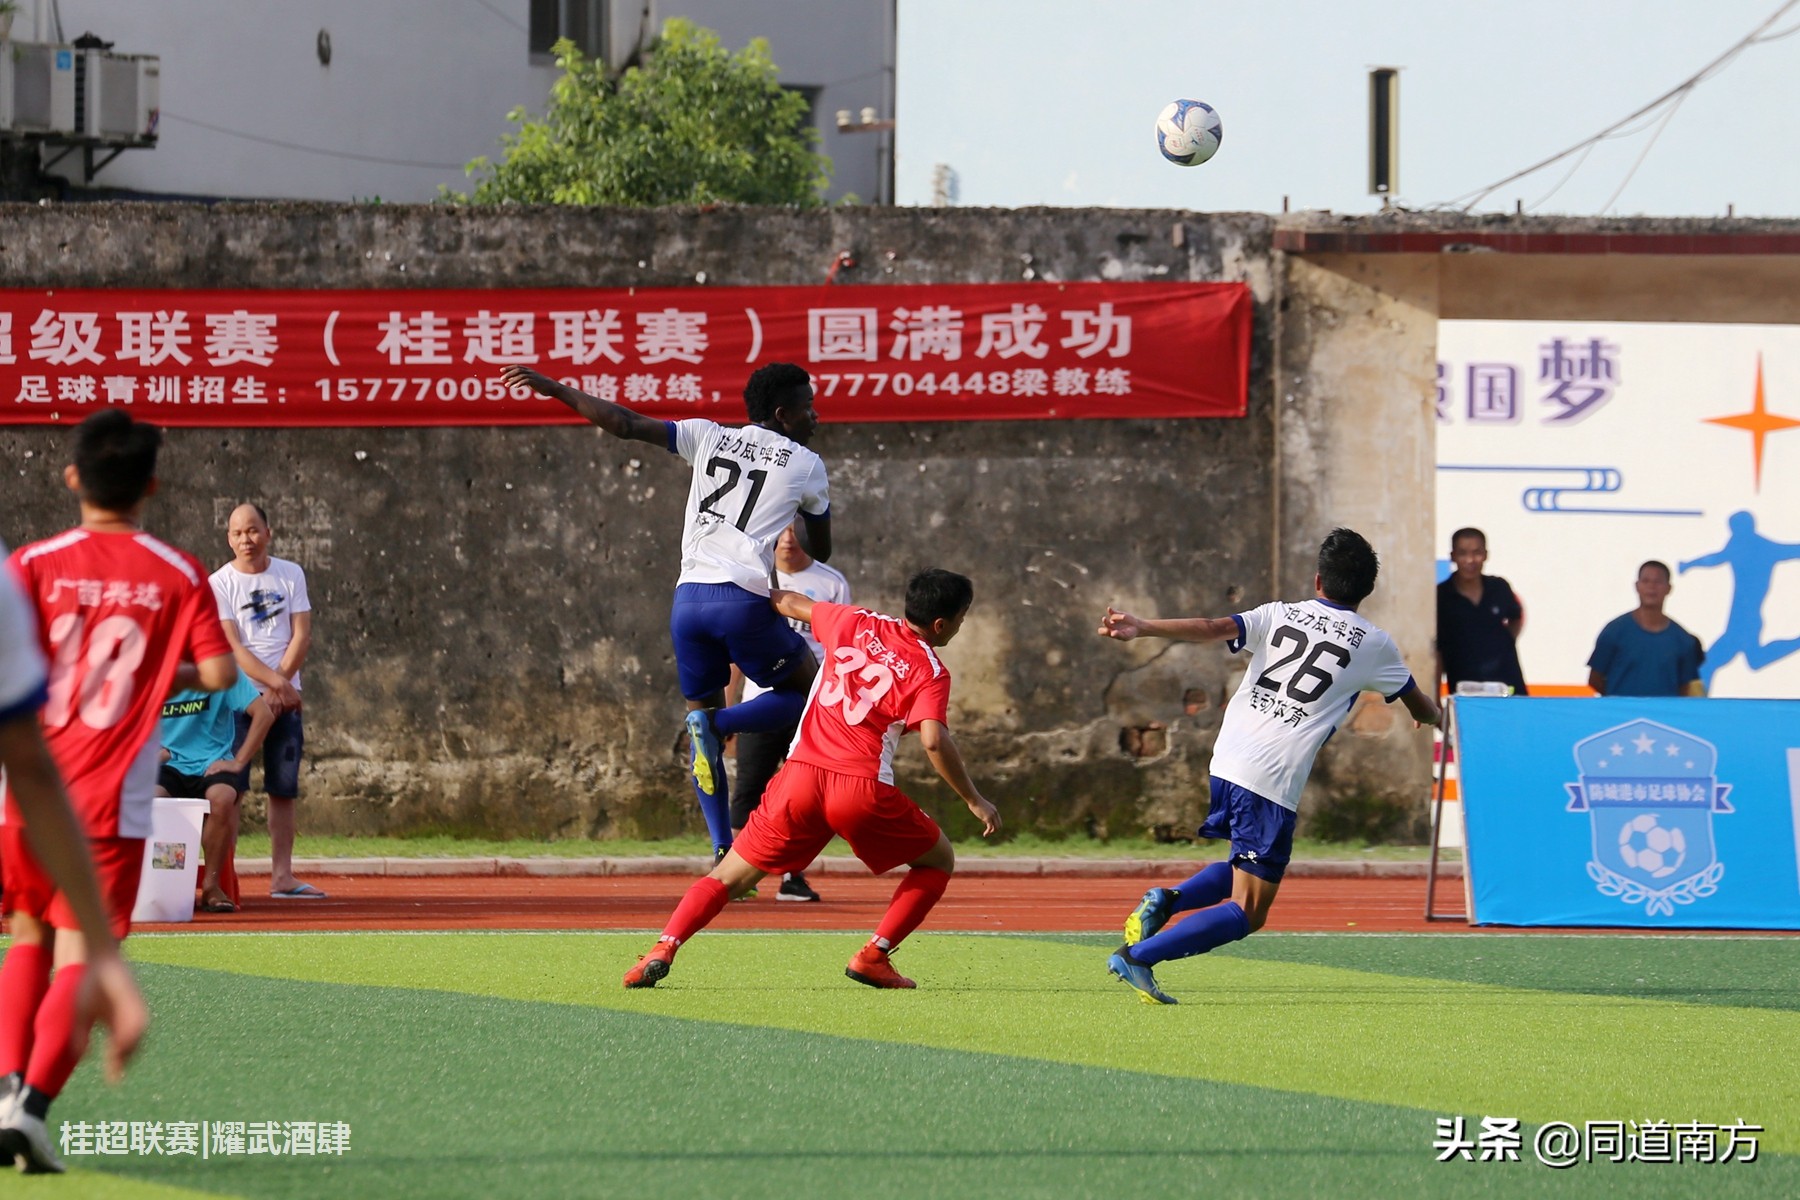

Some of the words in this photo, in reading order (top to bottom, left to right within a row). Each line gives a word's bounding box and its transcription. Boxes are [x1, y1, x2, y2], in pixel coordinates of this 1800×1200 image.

[699, 456, 768, 532] 21
[44, 611, 147, 730] 18
[818, 646, 893, 726] 33
[1256, 624, 1351, 704] 26
